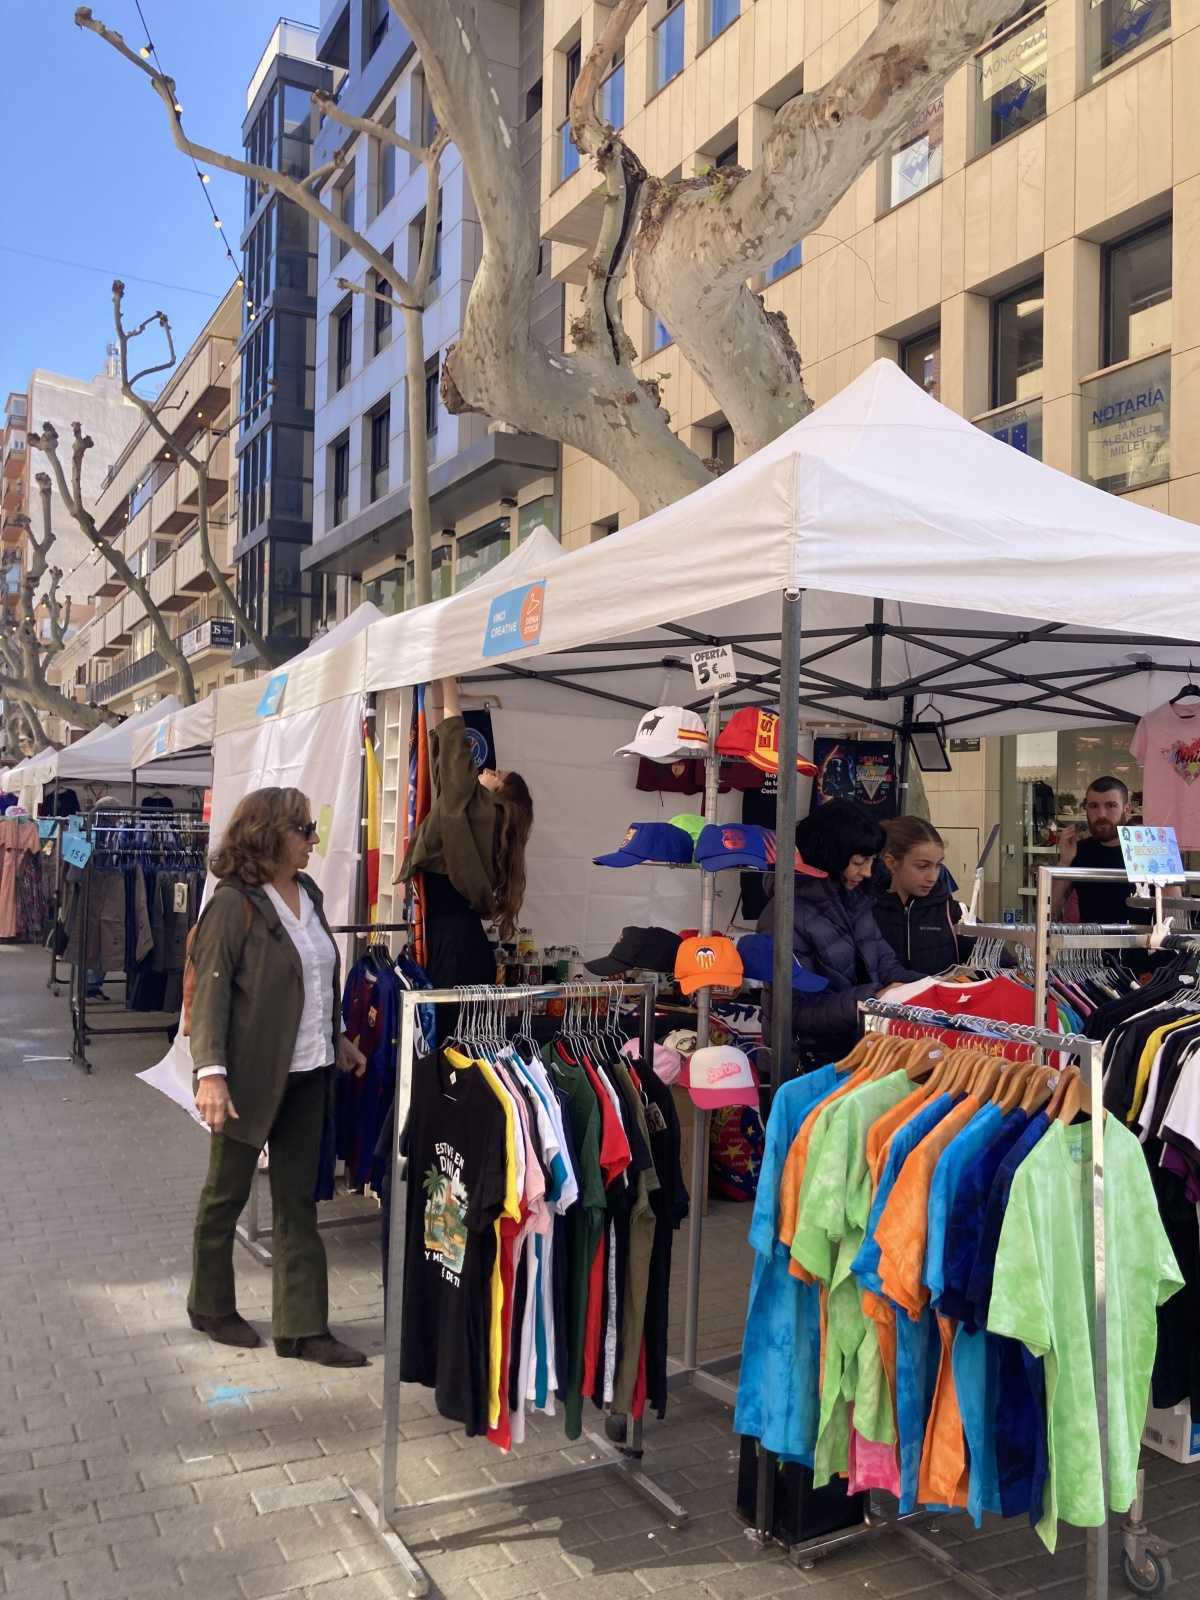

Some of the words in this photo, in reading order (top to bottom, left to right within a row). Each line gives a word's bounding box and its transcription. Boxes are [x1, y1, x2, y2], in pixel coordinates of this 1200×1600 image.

[1093, 387, 1165, 425] NOTARÍA
[490, 622, 517, 638] CREATIVE
[694, 648, 728, 662] OFERTA
[425, 1251, 430, 1261] Y
[433, 1251, 444, 1262] ME
